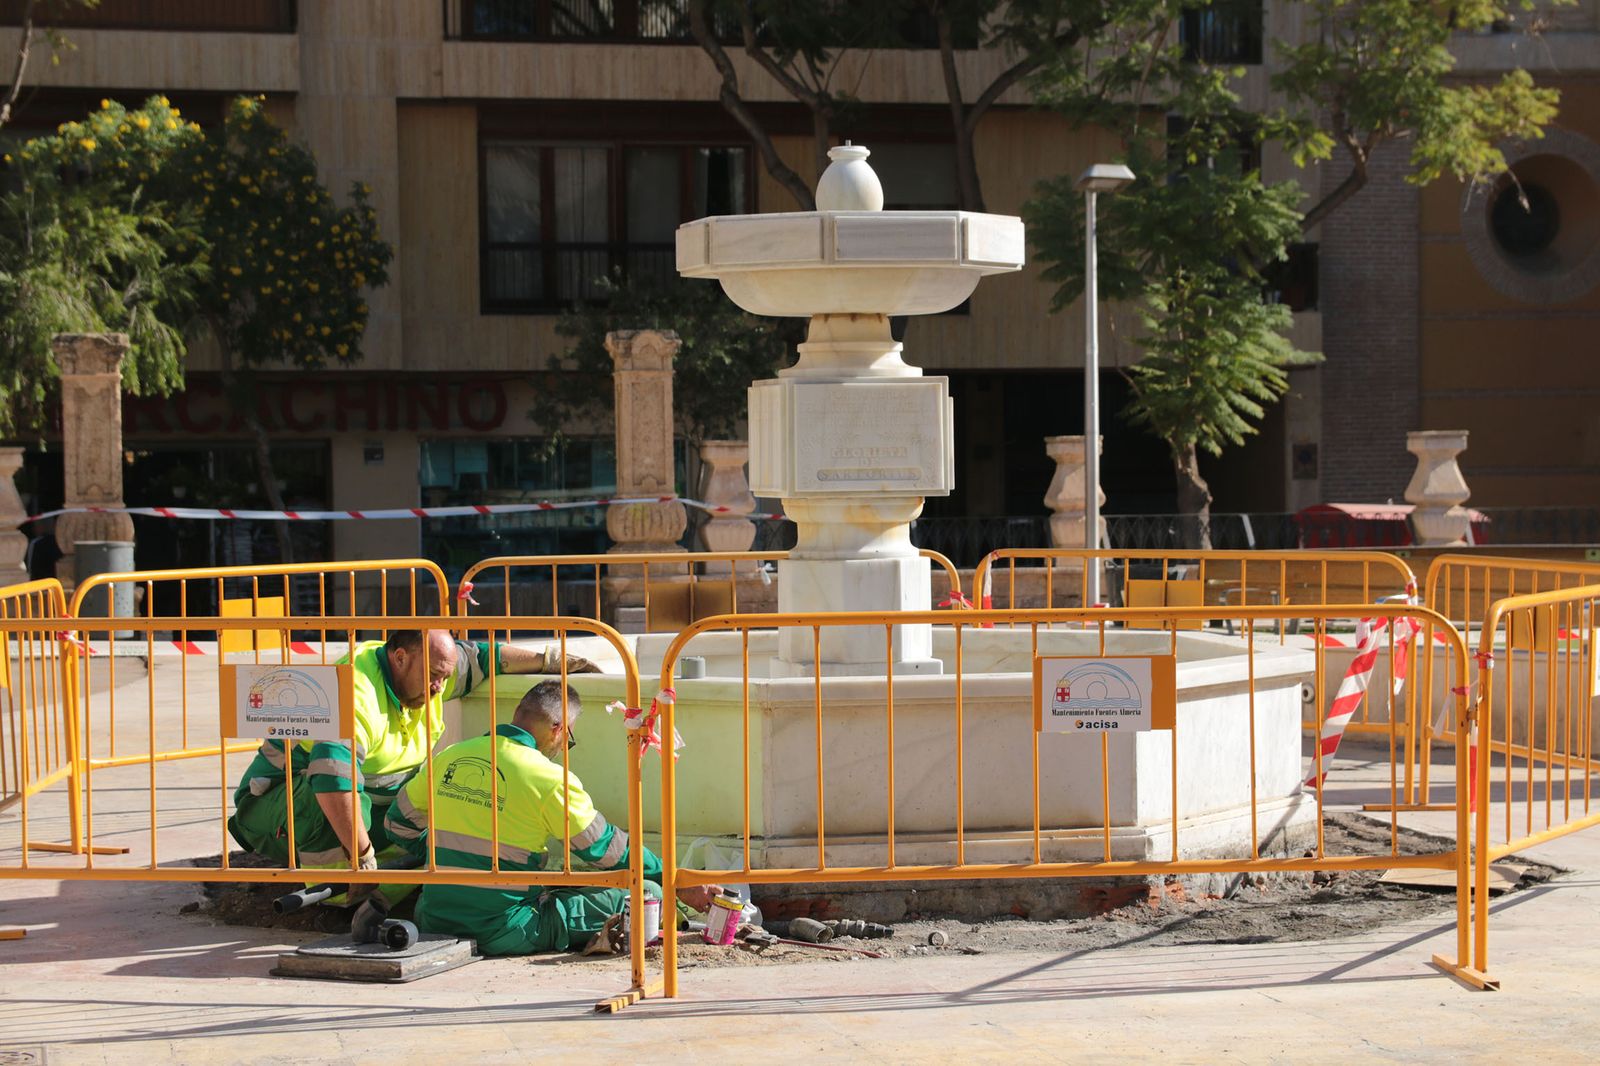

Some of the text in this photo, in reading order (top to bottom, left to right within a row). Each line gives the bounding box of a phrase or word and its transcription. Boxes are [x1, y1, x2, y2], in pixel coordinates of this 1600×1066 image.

[1052, 708, 1094, 716] Mantenimiento
[1095, 708, 1118, 716] Fuentes
[246, 714, 285, 723] Mantenimiento
[1085, 719, 1119, 729] acisa
[277, 726, 309, 736] acisa
